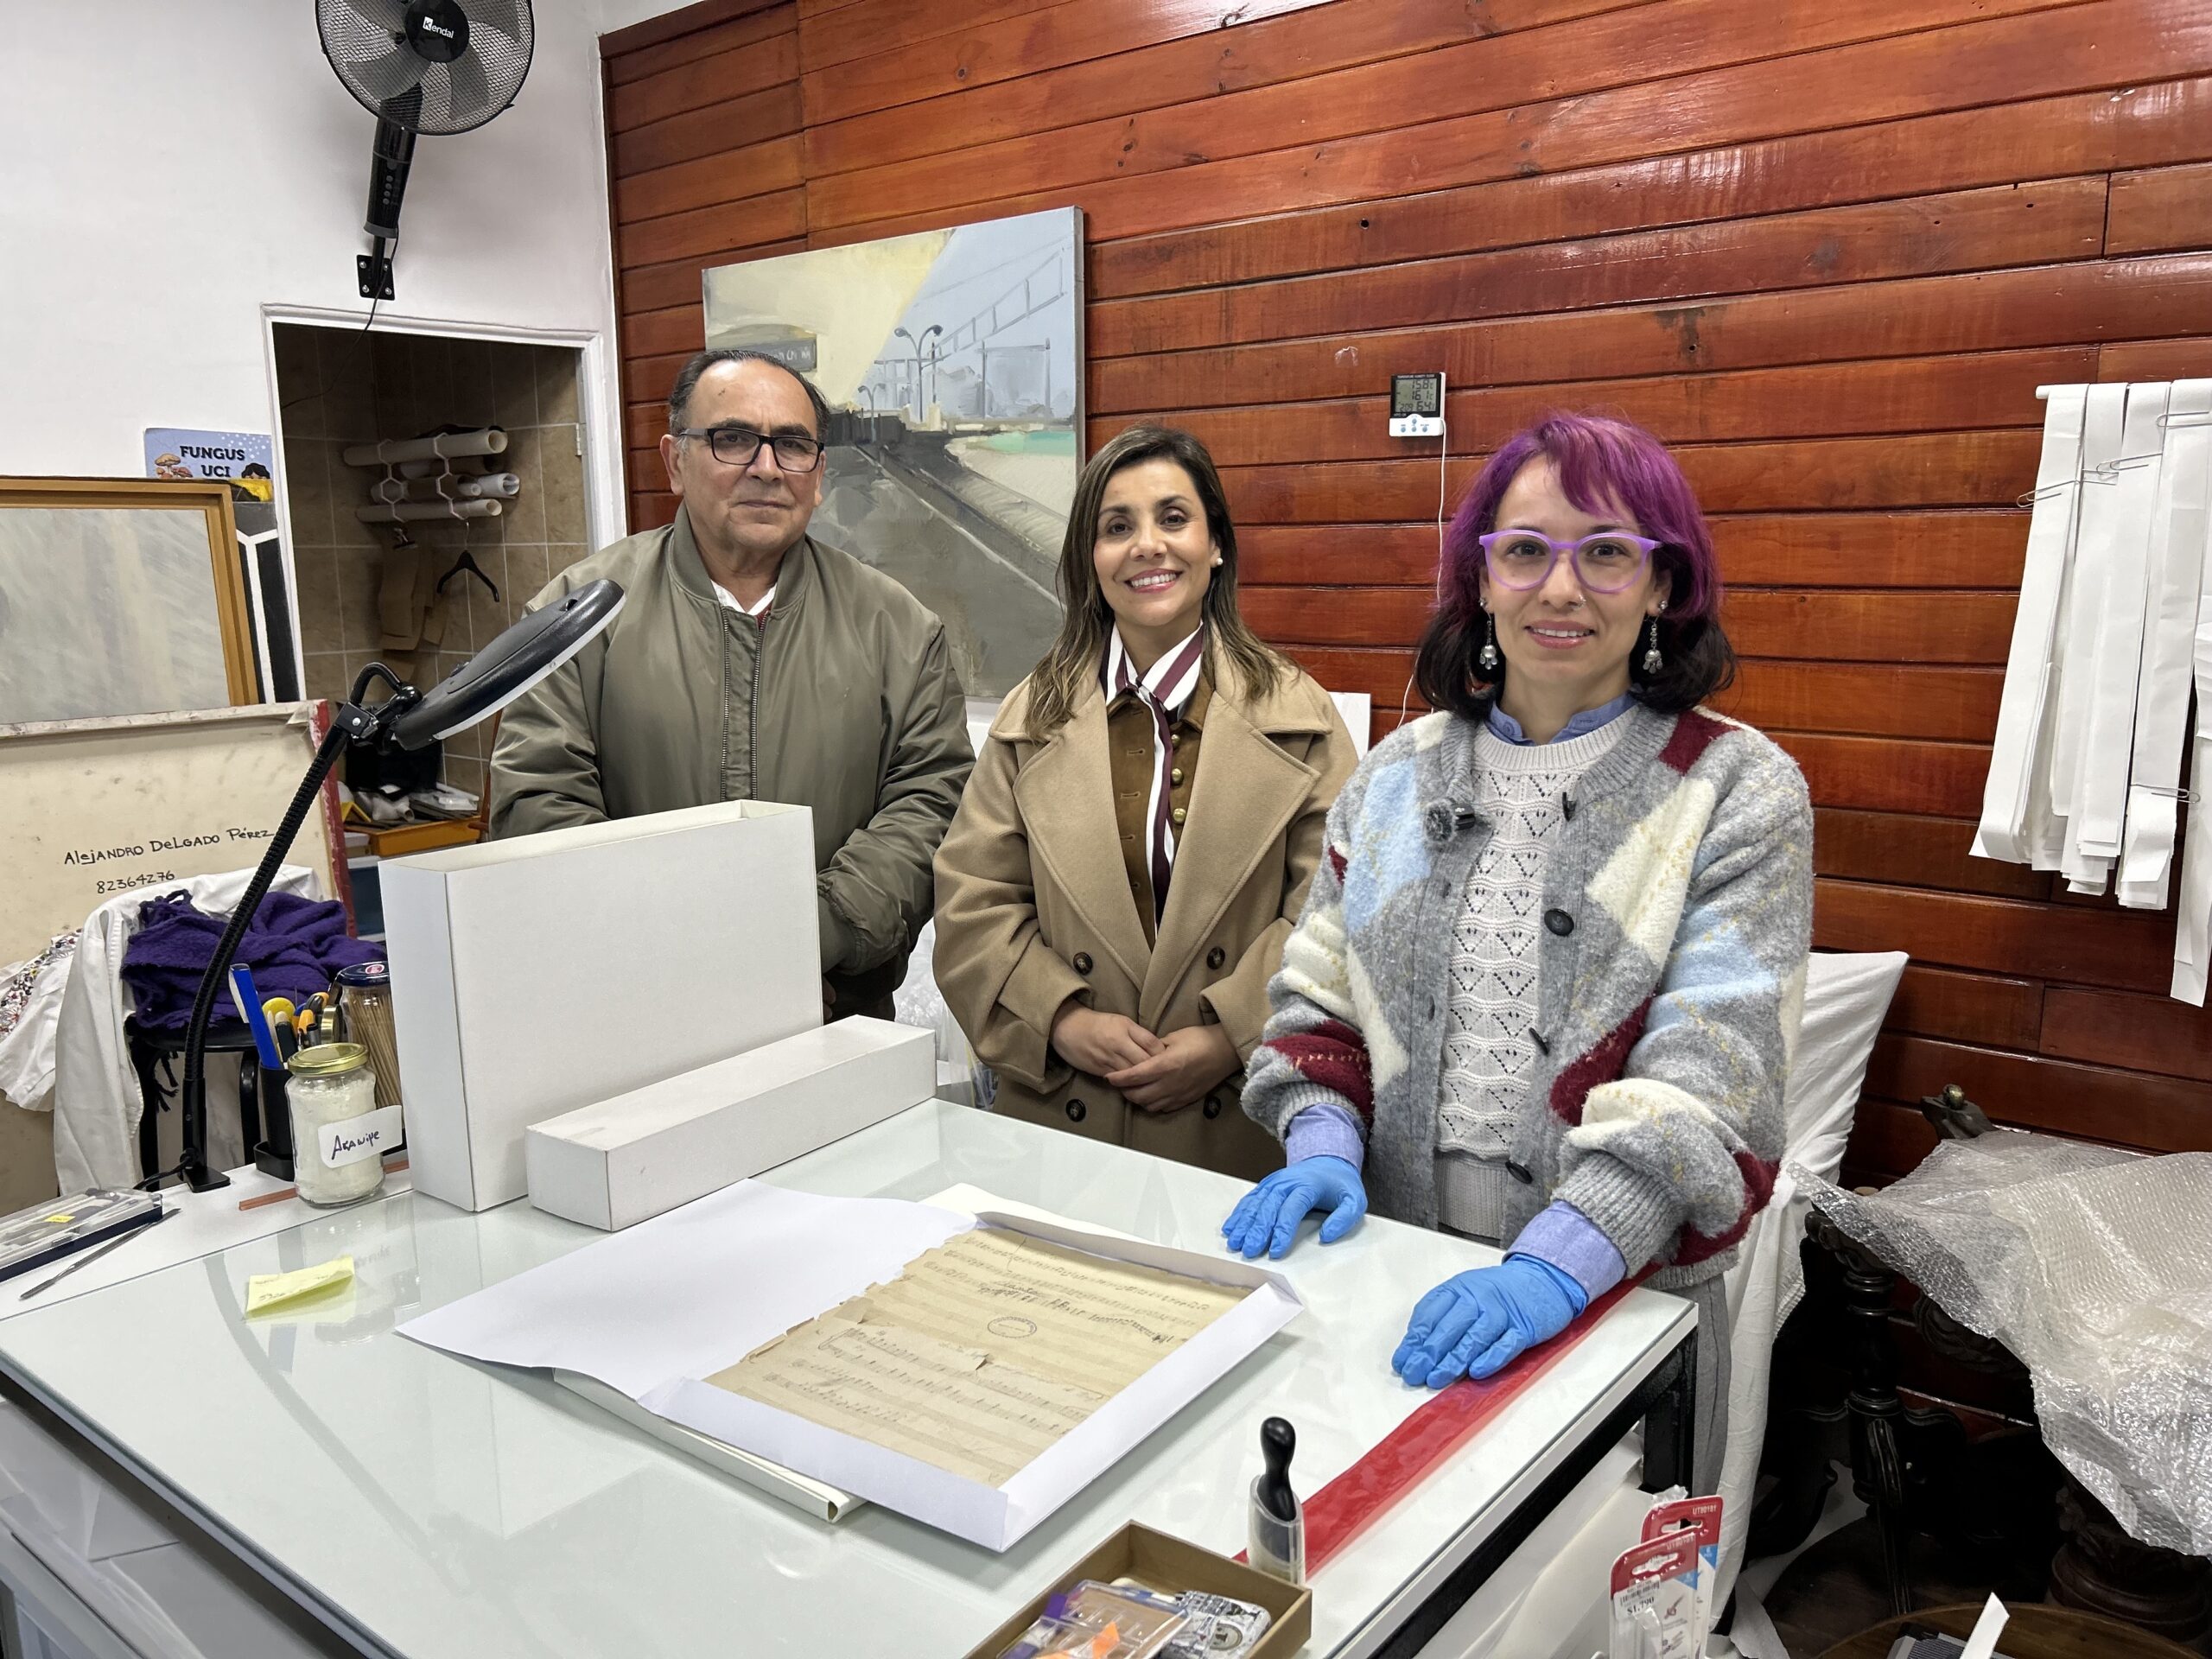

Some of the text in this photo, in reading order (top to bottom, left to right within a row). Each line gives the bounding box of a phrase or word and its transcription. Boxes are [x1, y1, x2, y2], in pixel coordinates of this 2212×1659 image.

[423, 16, 454, 39] Kendal
[180, 446, 245, 461] FUNGUS
[200, 464, 232, 478] UCI
[96, 869, 175, 894] 82364276
